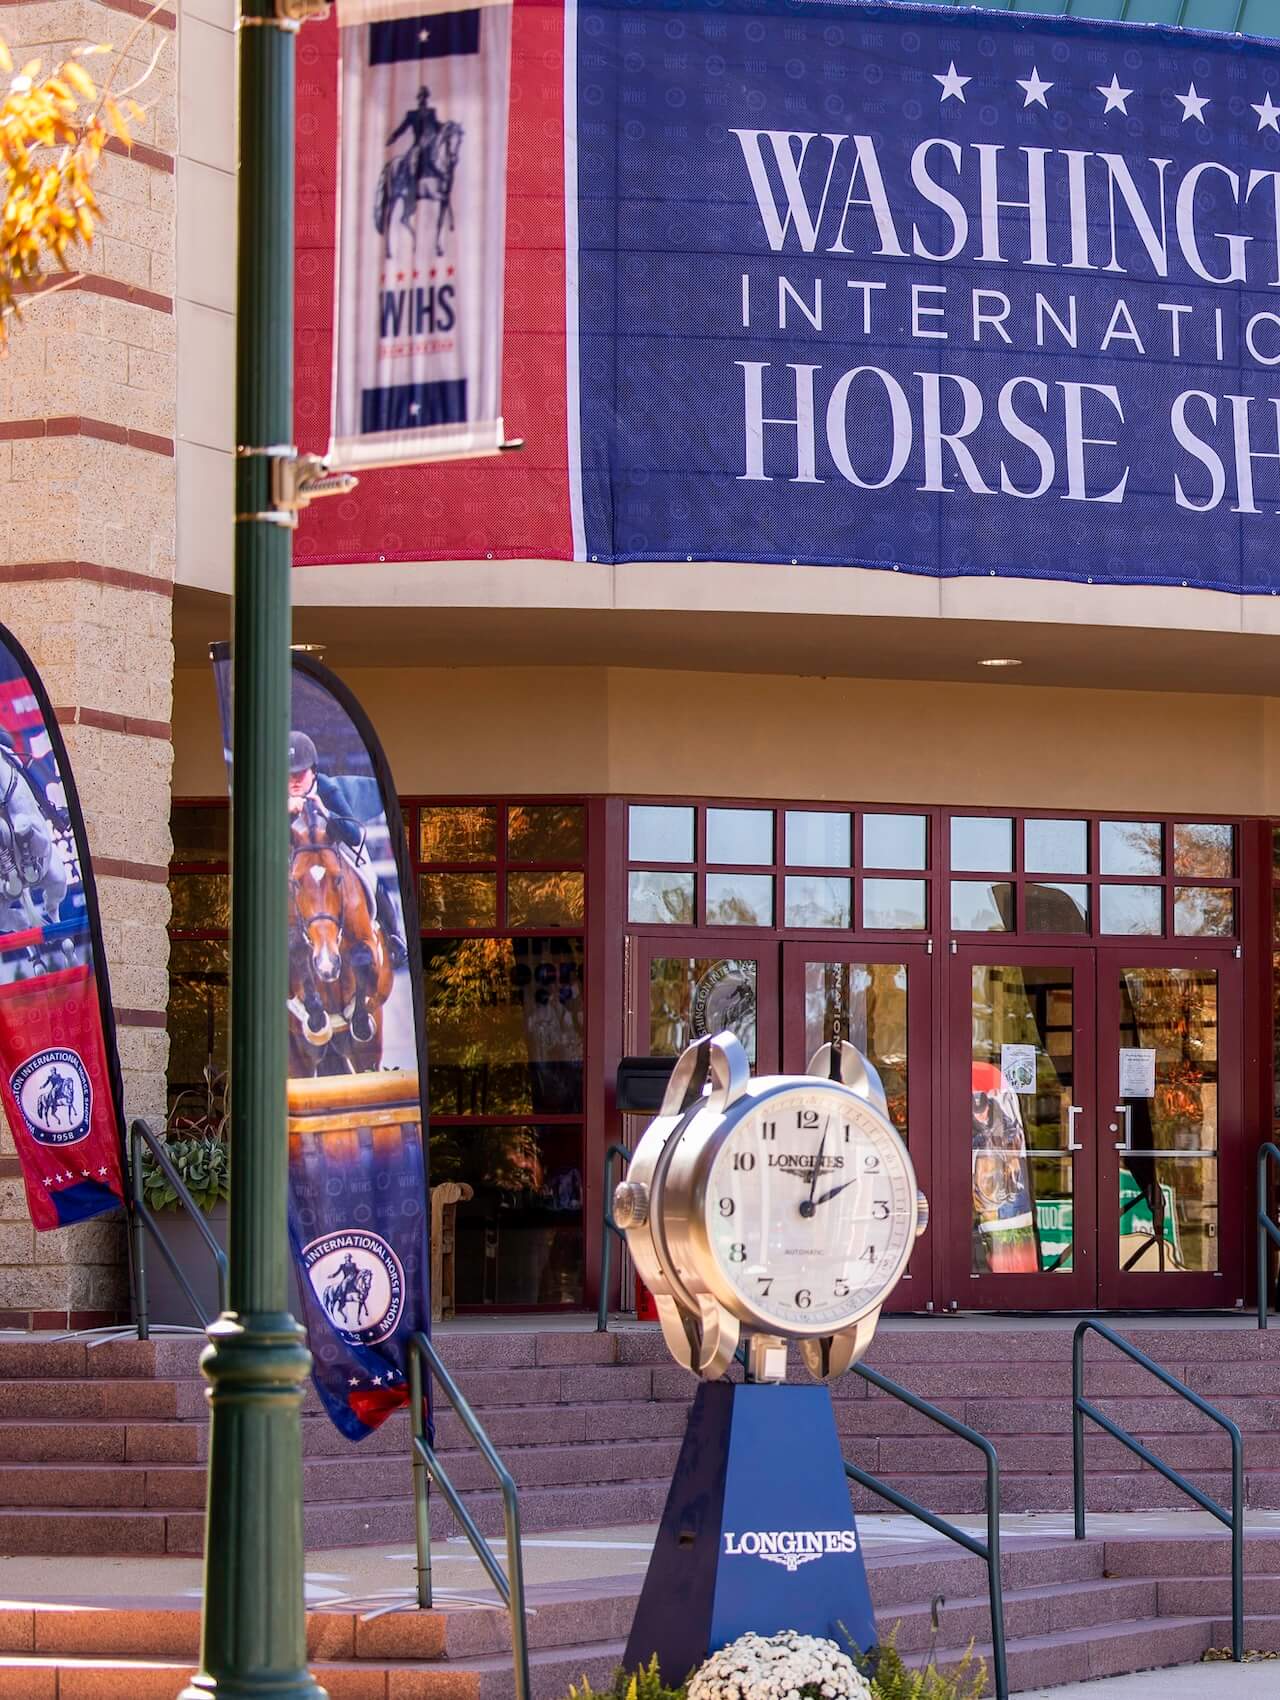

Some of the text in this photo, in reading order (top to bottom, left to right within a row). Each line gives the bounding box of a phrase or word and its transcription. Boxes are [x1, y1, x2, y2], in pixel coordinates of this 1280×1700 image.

[379, 284, 455, 338] WIHS
[734, 361, 1131, 504] HORSE
[21, 1052, 80, 1080] INTERNATIONAL
[796, 1111, 819, 1129] 12
[52, 1131, 74, 1141] 1958
[762, 1121, 776, 1140] 11
[843, 1124, 850, 1143] 1
[733, 1152, 755, 1171] 10
[768, 1154, 844, 1168] LONGINES
[864, 1155, 880, 1174] 2
[719, 1197, 735, 1217] 9
[872, 1200, 890, 1220] 3
[729, 1242, 747, 1262] 8
[859, 1245, 876, 1264] 4
[307, 1236, 400, 1332] INTERNATIONAL HORSE SHOW
[757, 1277, 774, 1296] 7
[834, 1278, 850, 1297] 5
[795, 1289, 811, 1308] 6
[723, 1531, 857, 1554] LONGINES
